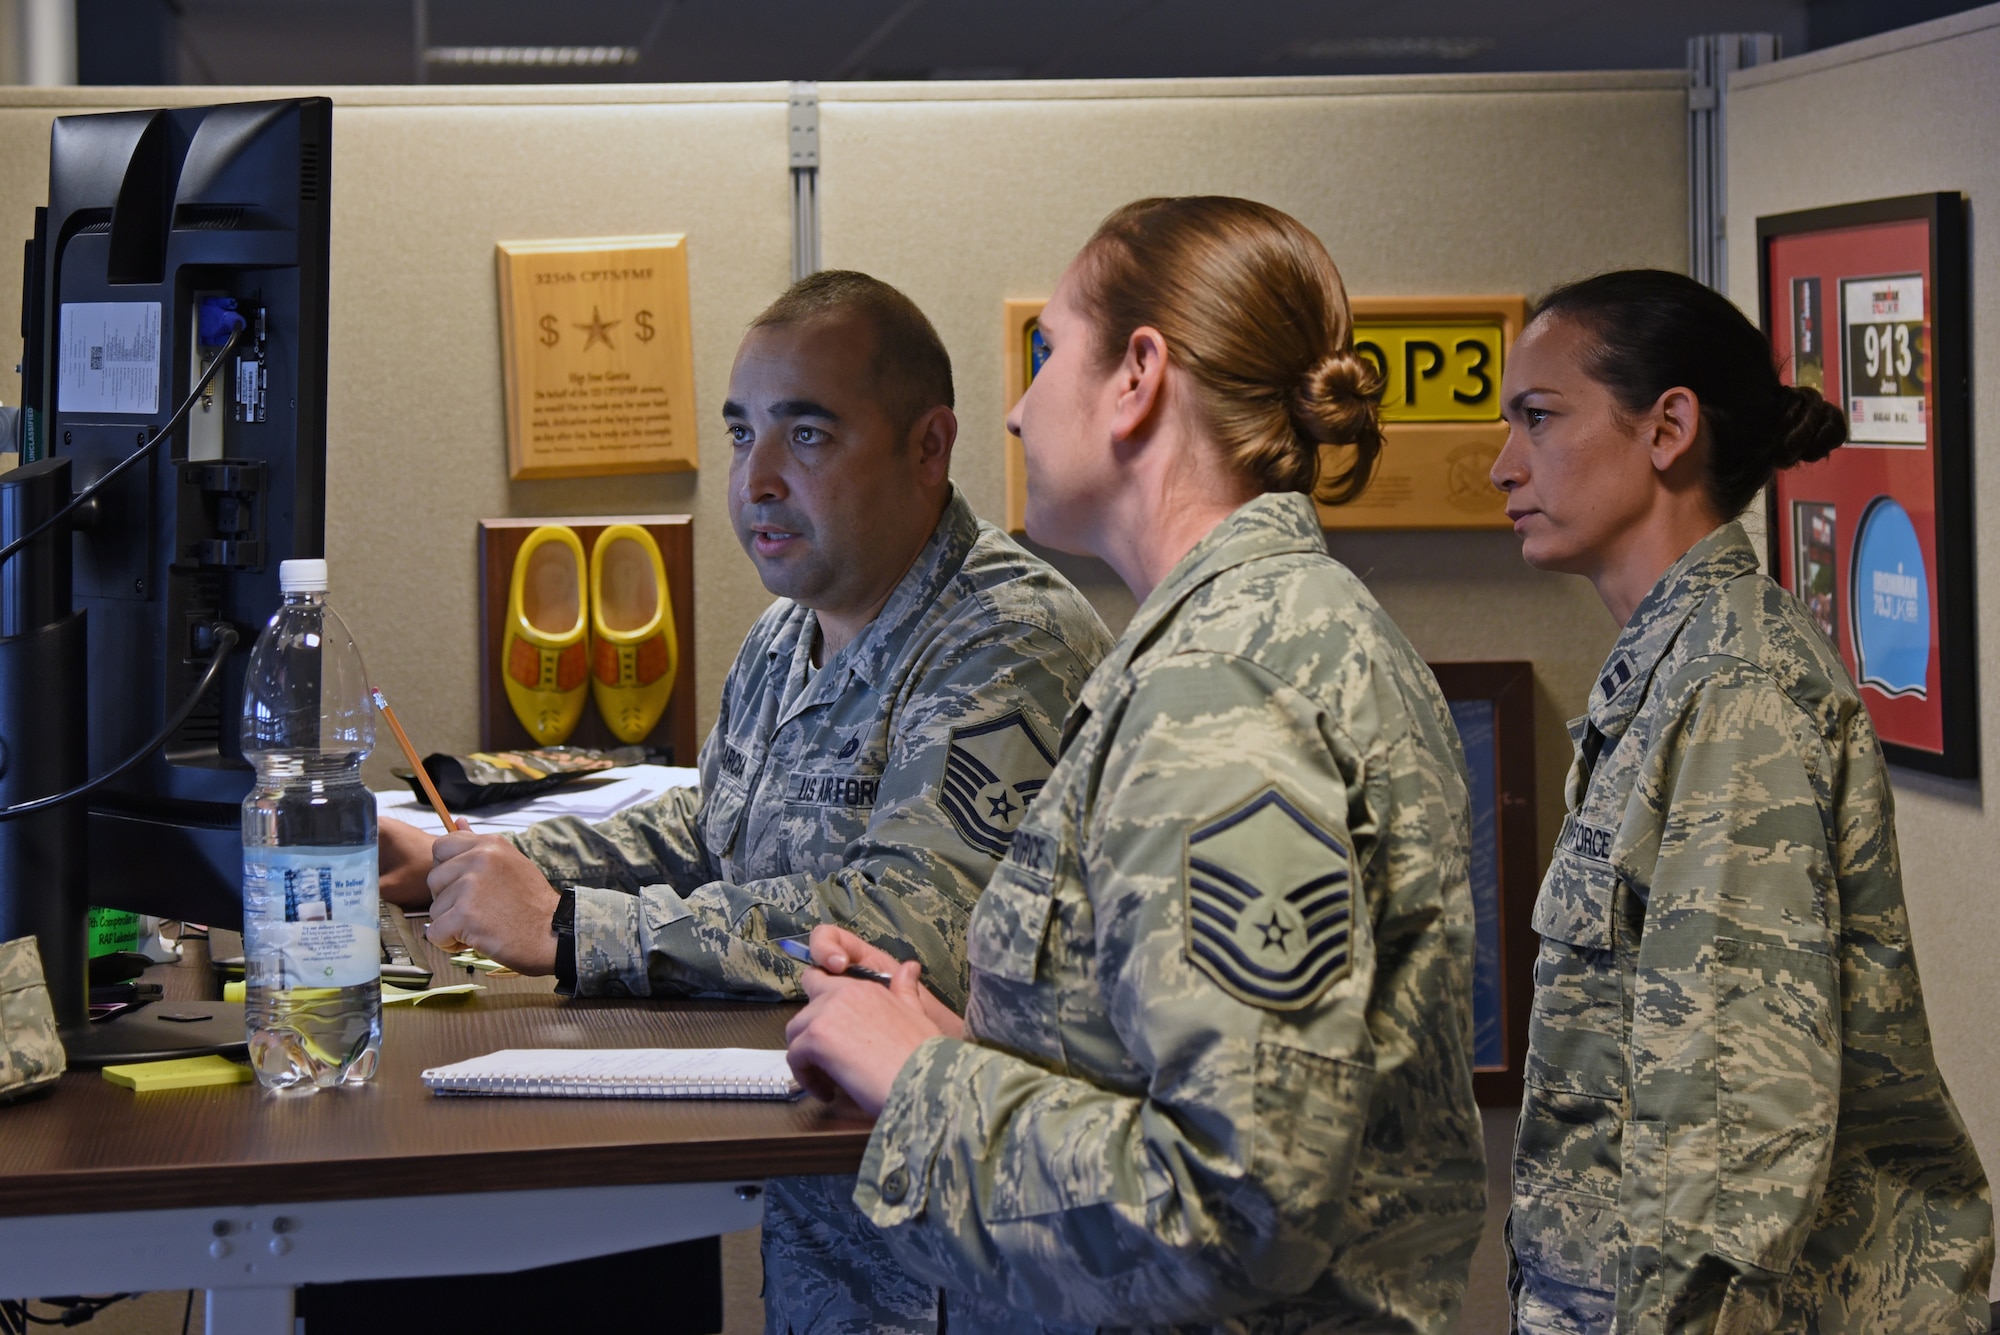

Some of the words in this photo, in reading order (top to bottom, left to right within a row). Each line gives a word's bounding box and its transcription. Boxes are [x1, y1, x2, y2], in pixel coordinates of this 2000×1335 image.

[1864, 323, 1912, 378] 913
[27, 407, 35, 462] UNCLASSIFIED
[1873, 570, 1918, 600] IRONMAN
[721, 746, 748, 780] ARCIA
[817, 776, 834, 803] AIR
[835, 777, 881, 805] FOR
[1571, 824, 1611, 858] FORCE
[89, 917, 98, 928] th
[99, 932, 113, 945] RAF
